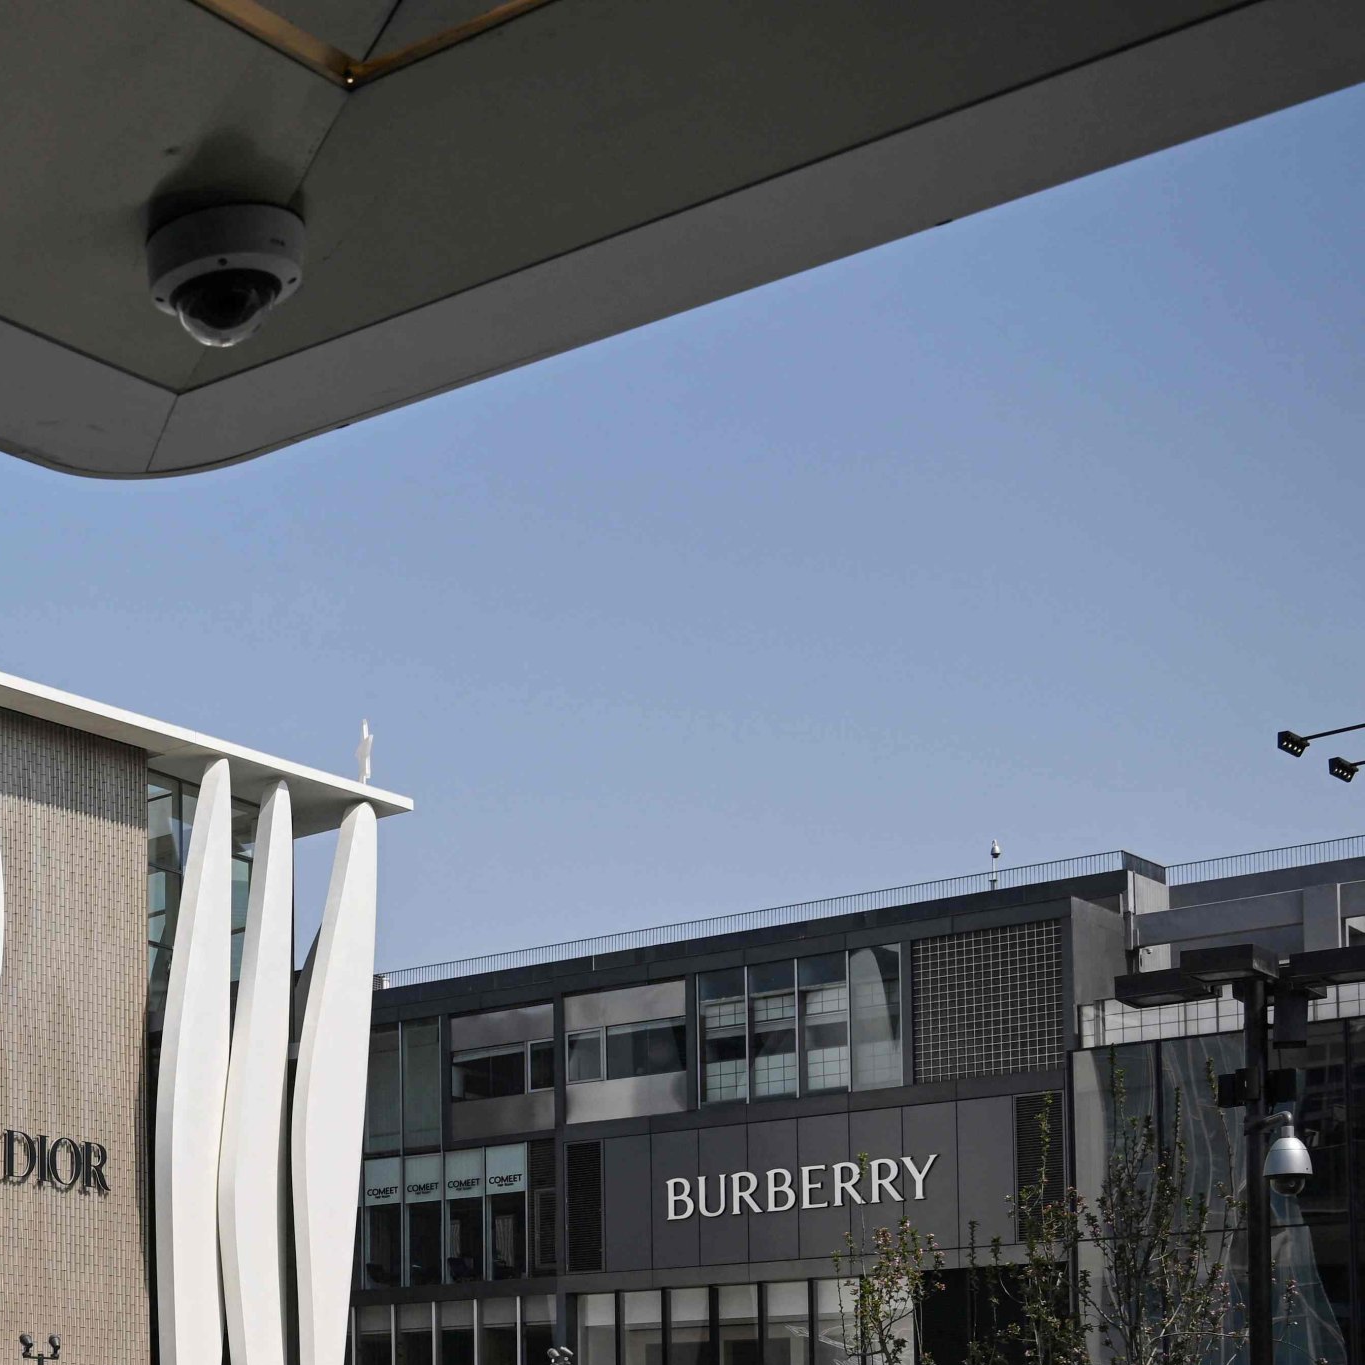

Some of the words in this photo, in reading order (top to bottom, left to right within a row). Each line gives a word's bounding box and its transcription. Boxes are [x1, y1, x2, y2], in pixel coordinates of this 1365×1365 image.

[3, 1128, 111, 1192] DIOR
[447, 1178, 481, 1188] COMEET
[488, 1174, 522, 1184] COMEET
[367, 1186, 398, 1196] COMEET
[407, 1182, 439, 1192] COMEET
[665, 1154, 938, 1221] BURBERRY
